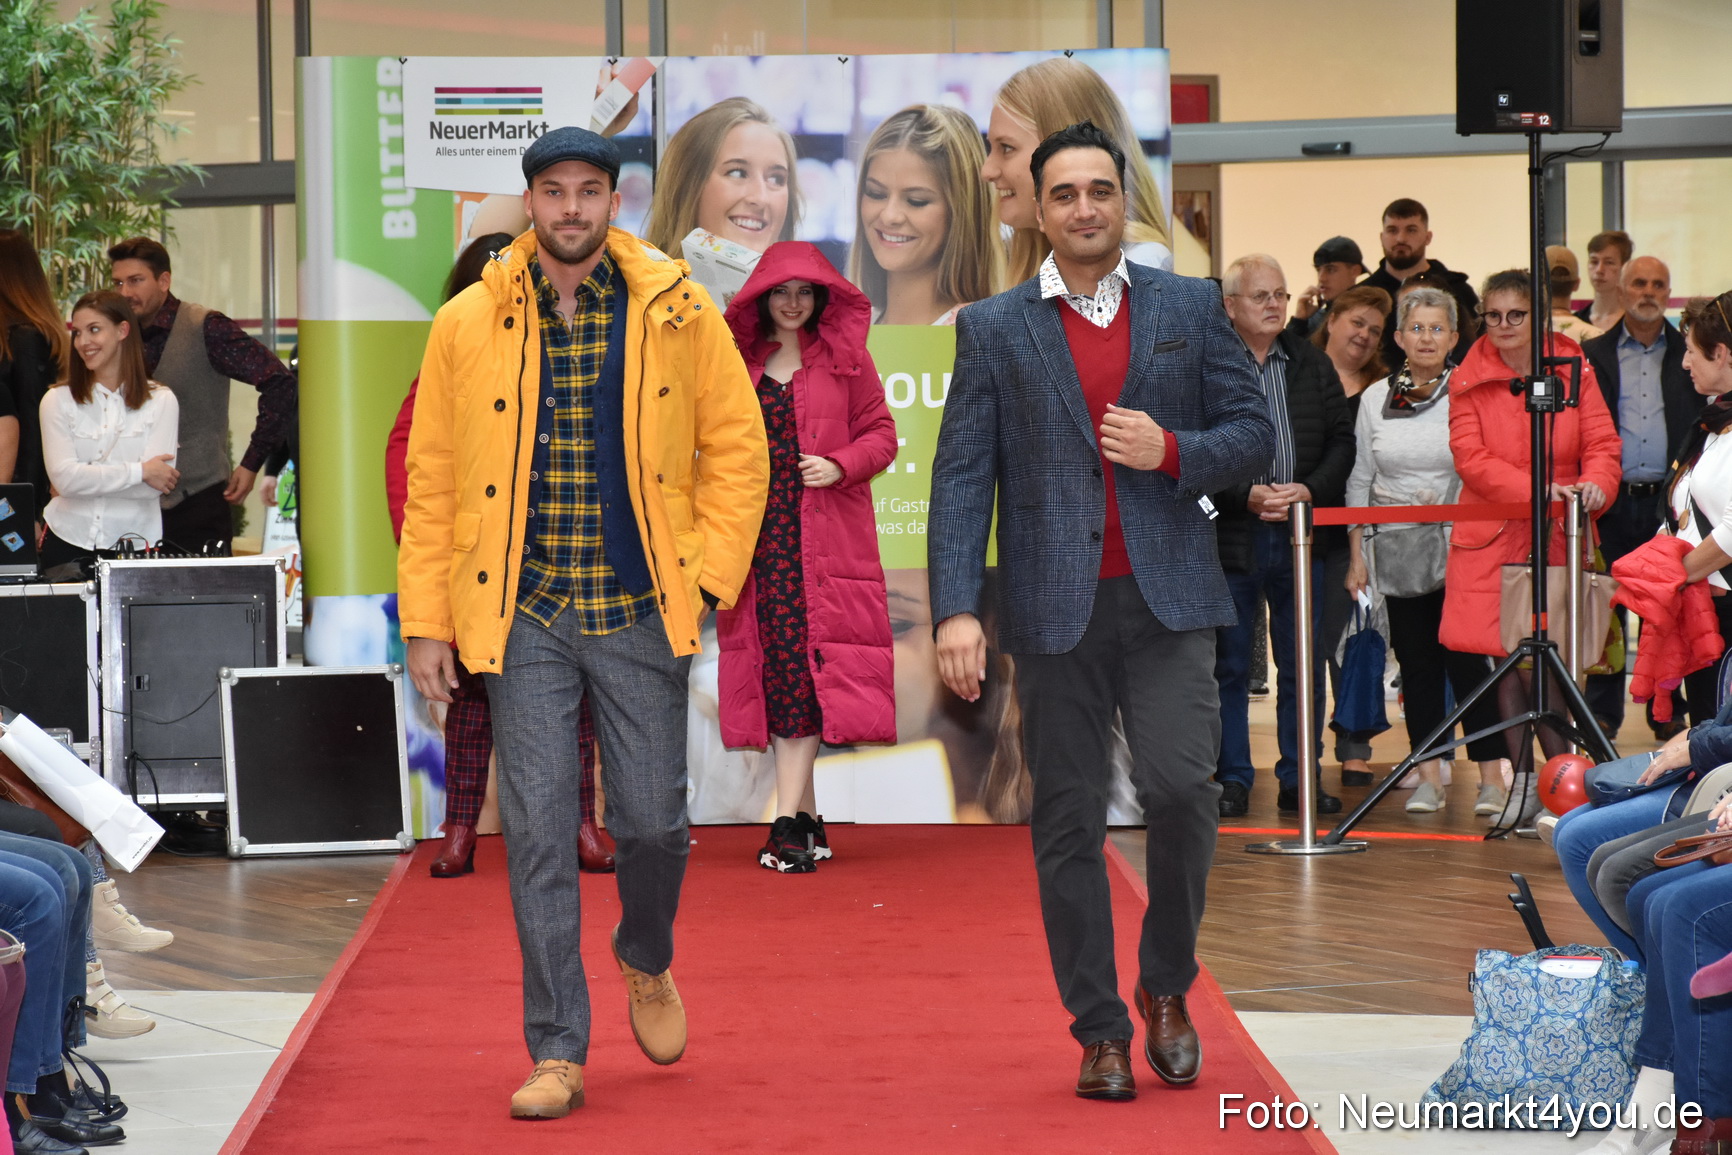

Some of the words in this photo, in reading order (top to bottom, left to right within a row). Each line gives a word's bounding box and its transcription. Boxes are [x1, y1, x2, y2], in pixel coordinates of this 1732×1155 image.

[1538, 115, 1550, 125] 12
[429, 119, 549, 140] NeuerMarkt
[377, 57, 417, 238] BUTTER
[435, 147, 458, 156] Alles
[459, 147, 485, 156] unter
[486, 146, 517, 156] einem
[878, 372, 953, 409] ou
[873, 497, 887, 513] uf
[890, 497, 930, 513] Gastr
[907, 519, 926, 535] da
